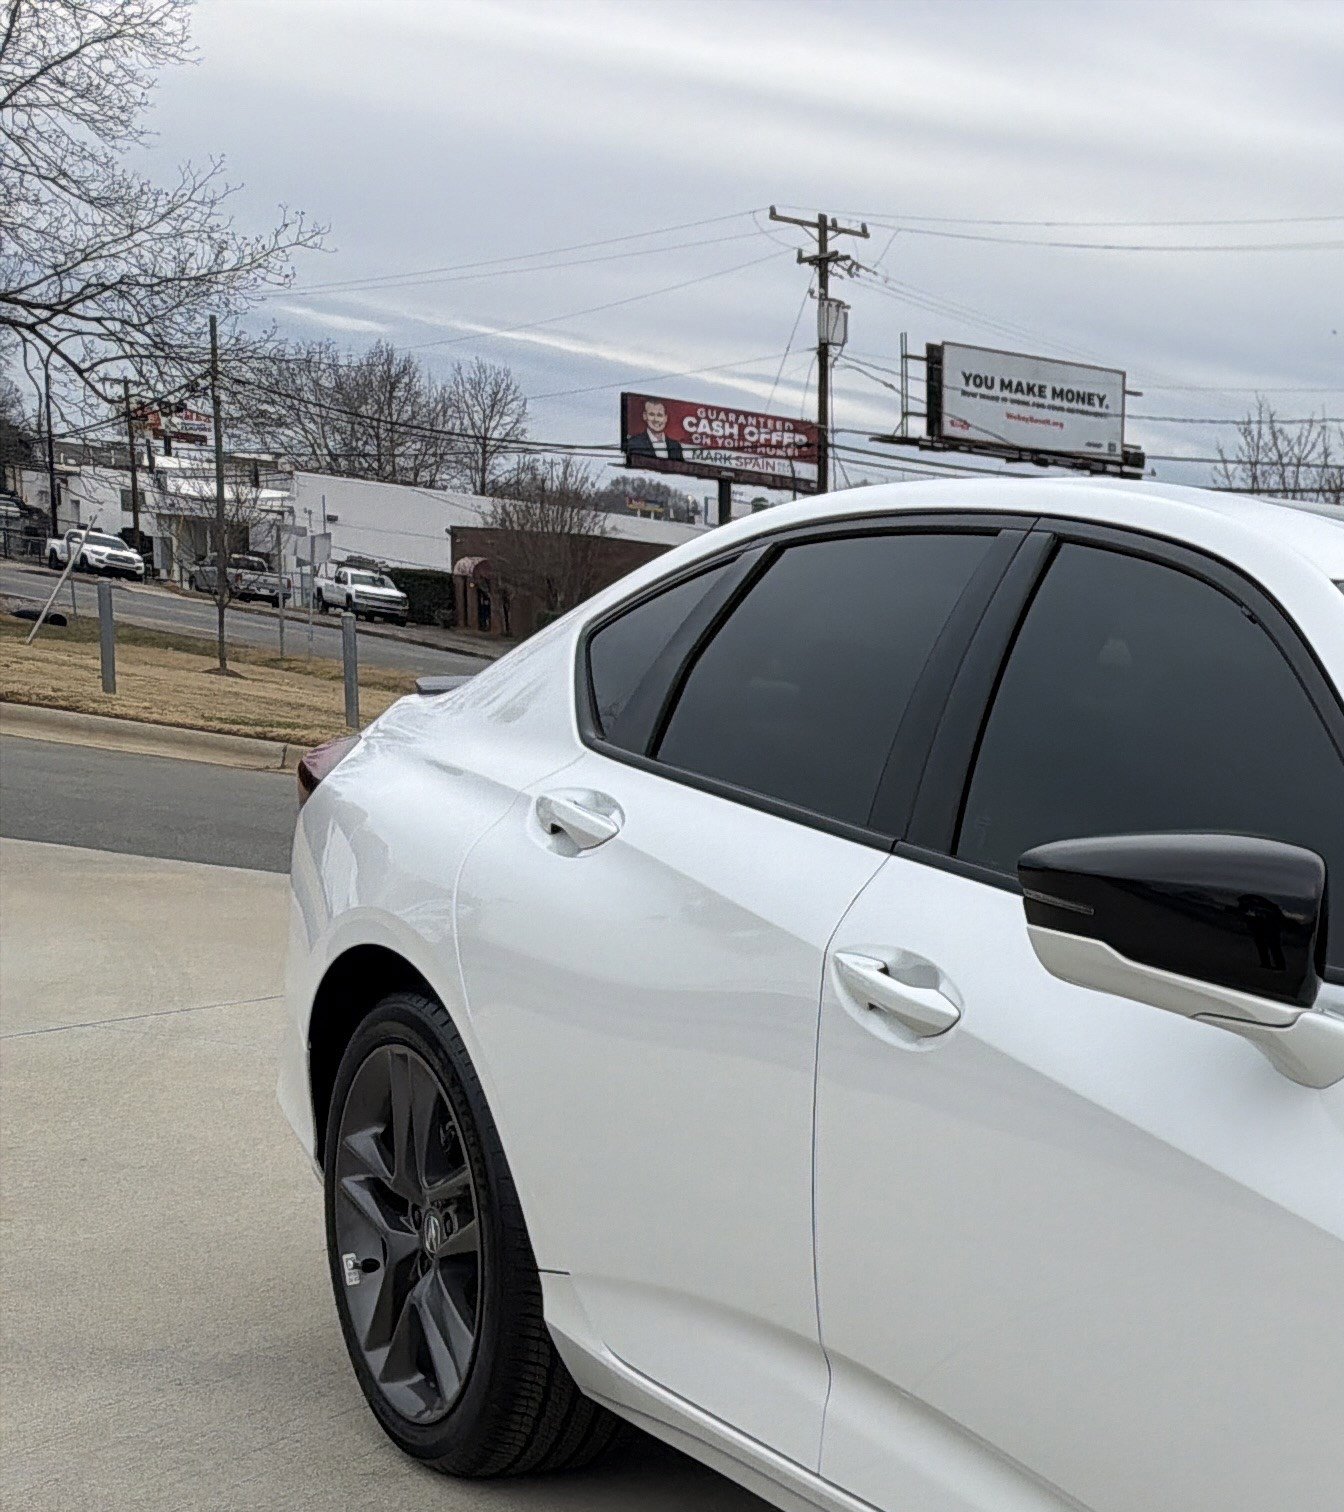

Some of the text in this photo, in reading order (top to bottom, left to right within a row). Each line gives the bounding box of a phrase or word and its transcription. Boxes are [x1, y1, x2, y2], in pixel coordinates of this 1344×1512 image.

[961, 371, 995, 391] YOU
[1000, 377, 1048, 399] MAKE
[1052, 386, 1110, 410] MONEY.
[683, 416, 739, 439] CASH
[697, 407, 794, 431] GUARANTEED
[691, 449, 732, 465] MARK
[735, 456, 776, 472] SPAIN
